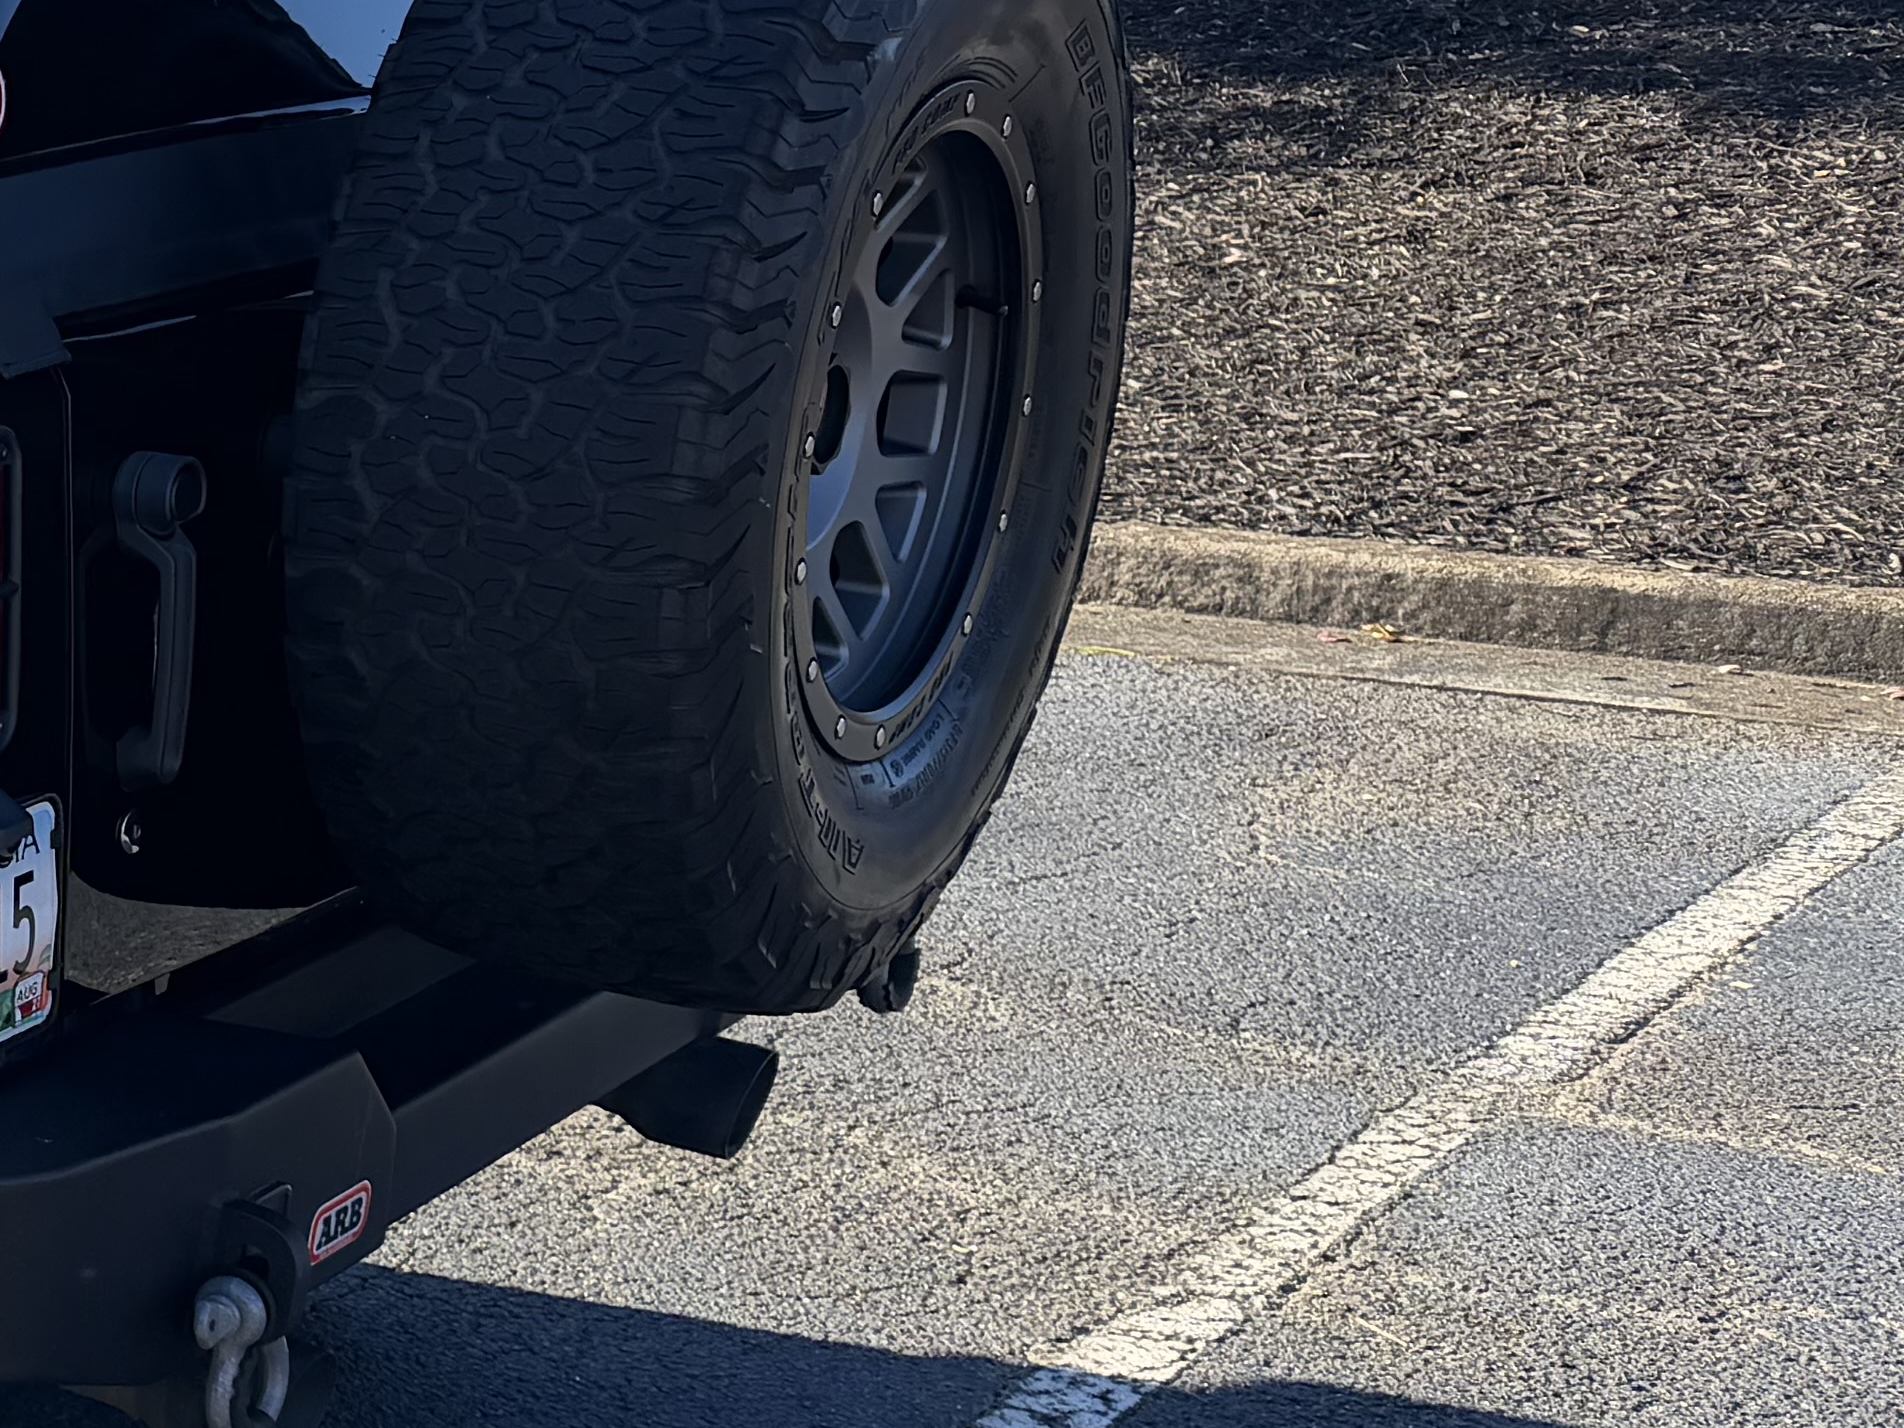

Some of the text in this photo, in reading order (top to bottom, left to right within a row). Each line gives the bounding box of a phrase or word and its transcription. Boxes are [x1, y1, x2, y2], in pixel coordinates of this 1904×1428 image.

[1049, 18, 1114, 575] BFGoodrich
[17, 981, 38, 1001] AUG
[315, 1196, 363, 1251] ARB
